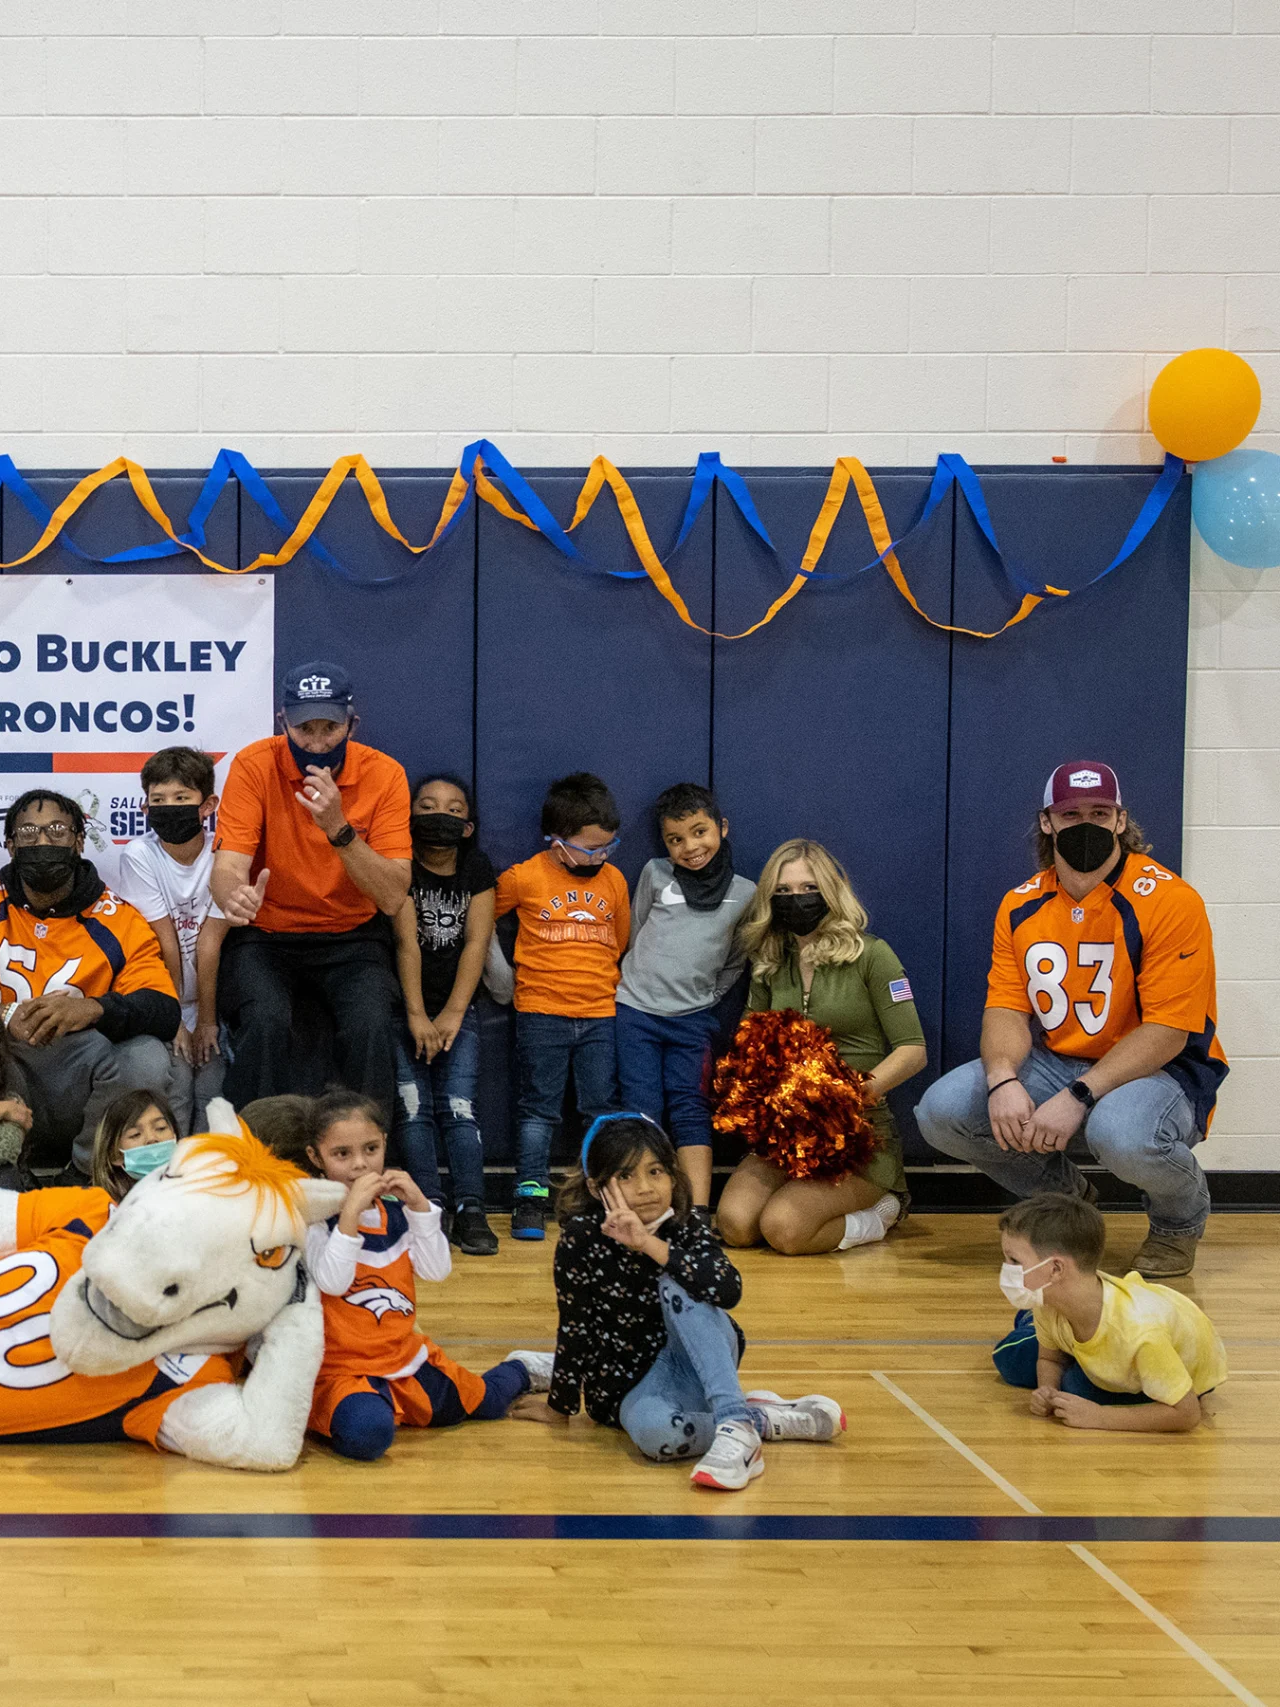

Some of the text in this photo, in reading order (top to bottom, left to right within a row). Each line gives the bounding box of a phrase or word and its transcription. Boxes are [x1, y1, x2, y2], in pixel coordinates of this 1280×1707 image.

[36, 633, 248, 673] BUCKLEY
[1132, 864, 1173, 897] 83
[1024, 941, 1116, 1037] 83
